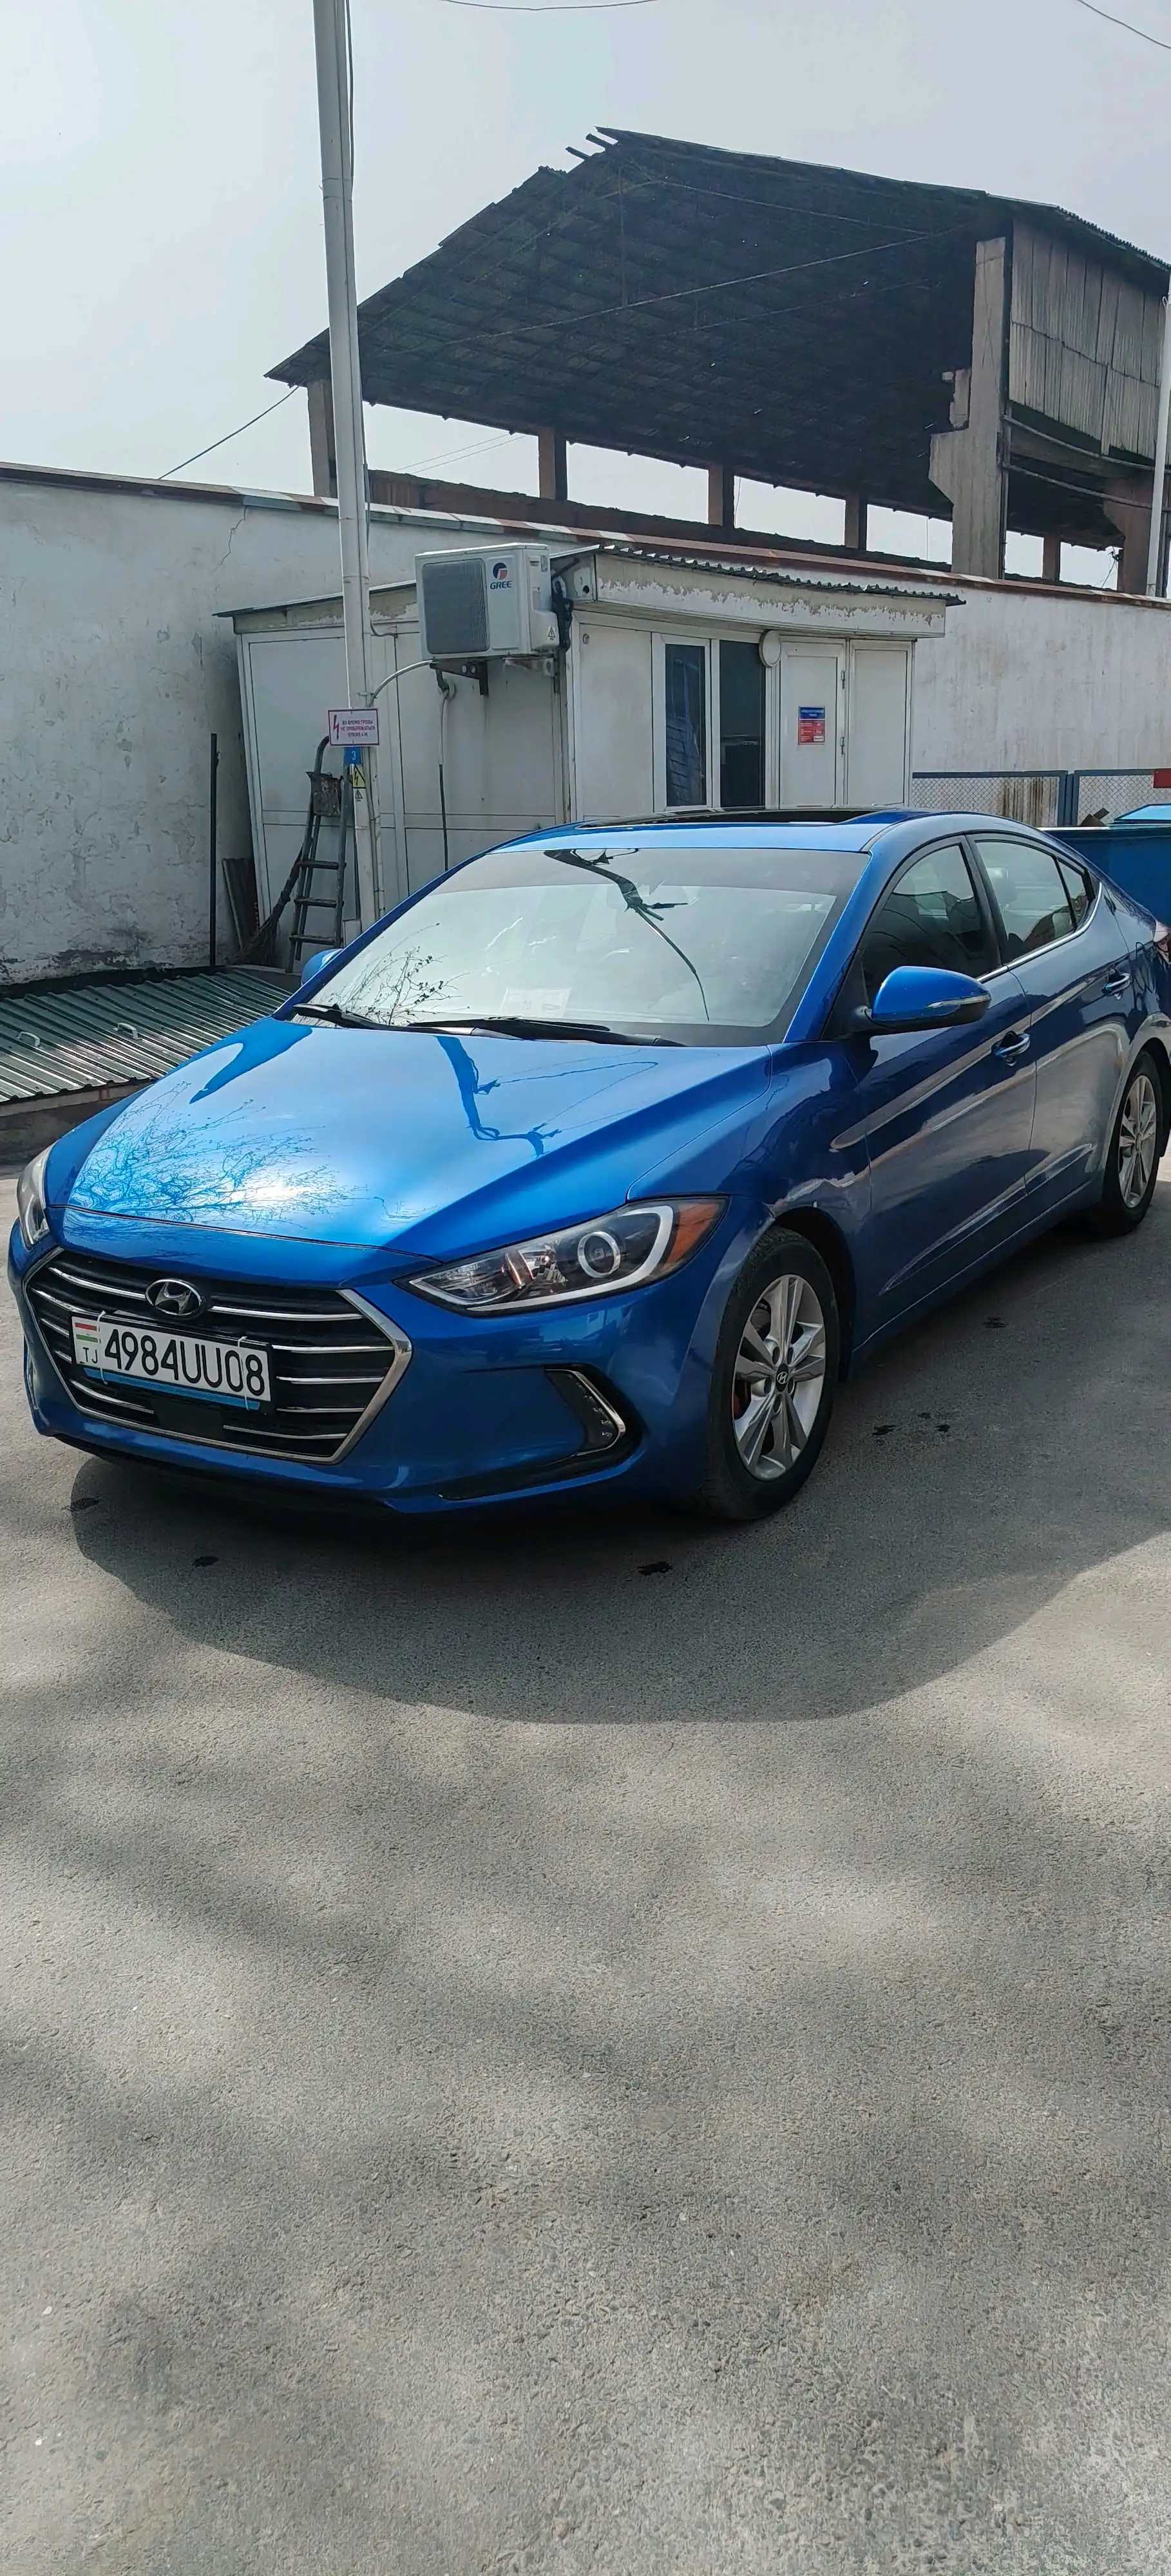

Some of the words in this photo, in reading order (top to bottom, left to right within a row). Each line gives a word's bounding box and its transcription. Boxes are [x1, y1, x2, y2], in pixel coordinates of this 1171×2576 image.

[490, 580, 513, 590] GREE
[82, 1347, 98, 1364] TJ
[104, 1329, 265, 1396] 4984UU08
